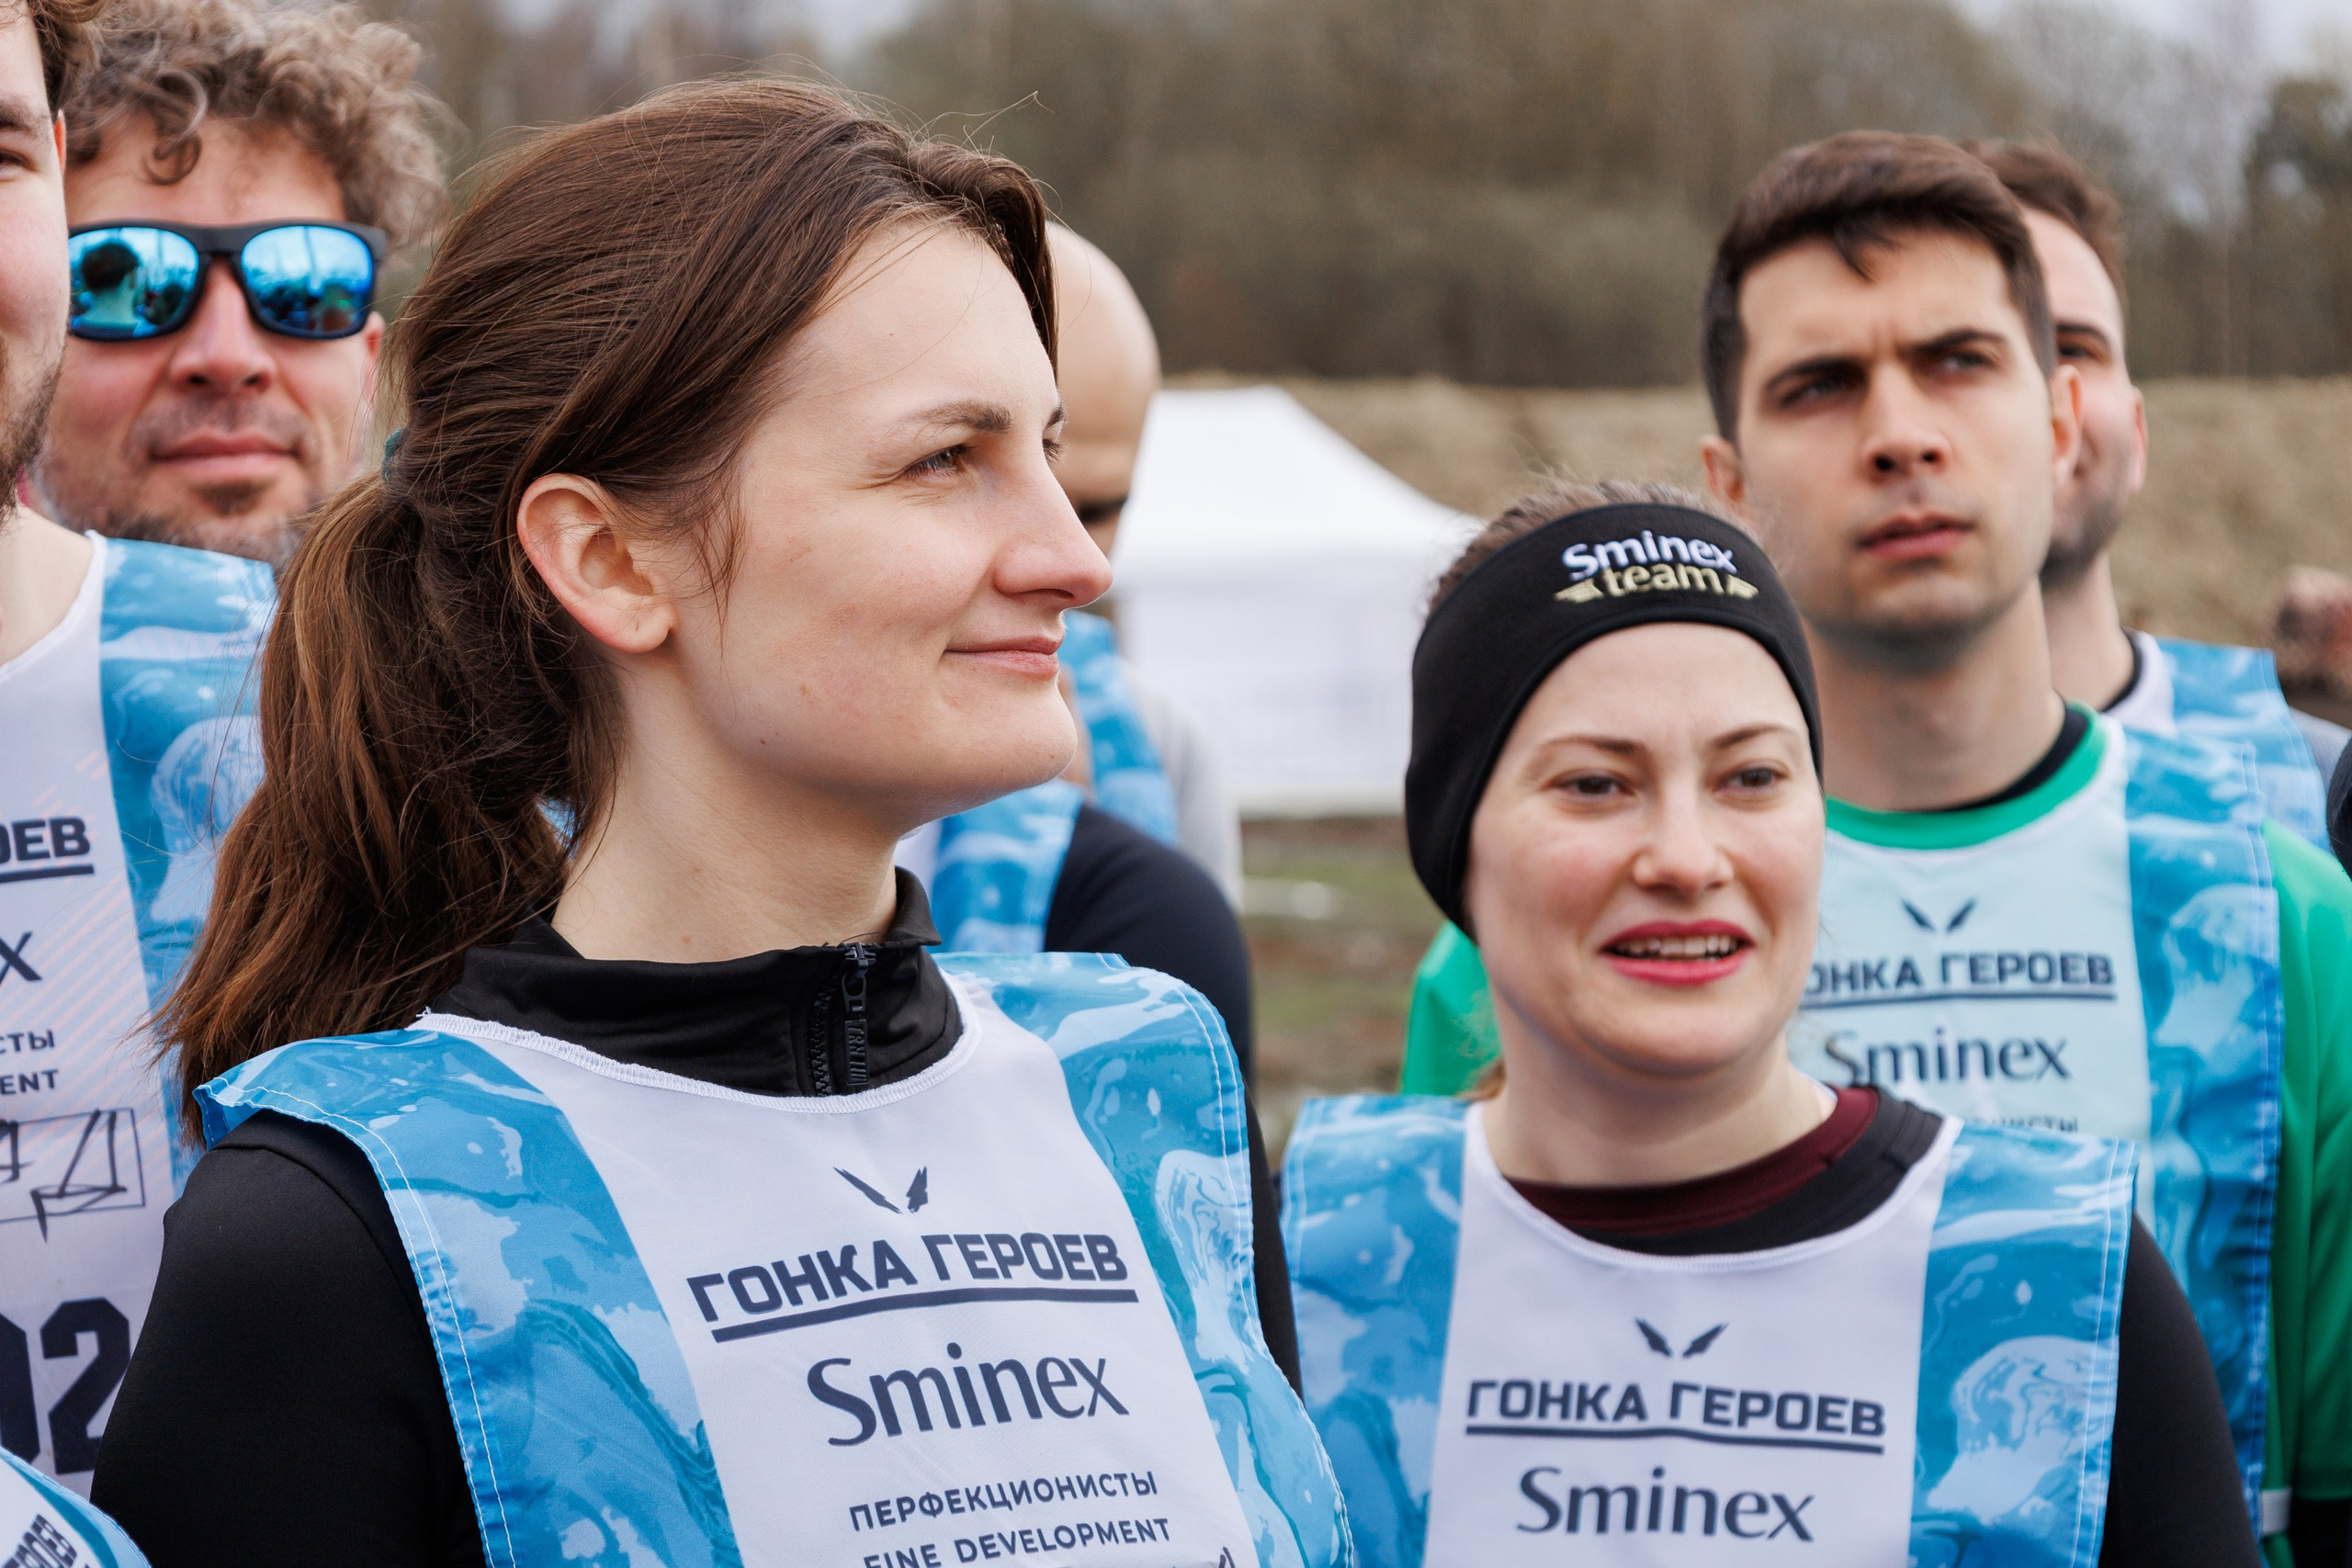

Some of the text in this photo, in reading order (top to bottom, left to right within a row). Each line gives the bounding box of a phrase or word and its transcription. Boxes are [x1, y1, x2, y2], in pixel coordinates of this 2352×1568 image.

[1562, 530, 1737, 581] Sminex
[1602, 563, 1724, 596] team
[0, 817, 90, 863] ЕВ
[1804, 952, 2116, 994] ОНКА ГЕРОЕВ
[1825, 1025, 2071, 1087] Sminex
[686, 1233, 1128, 1322] ГОНКА ГЕРОЕВ
[808, 1342, 1129, 1447] Sminex
[1467, 1380, 1885, 1438] ГОНКА ГЕРОЕВ
[849, 1471, 1158, 1531] ПЕРФЕКЦИОНИСТЫ
[1517, 1467, 1815, 1542] Sminex
[863, 1517, 1170, 1568] FINE DEVELOPMENT
